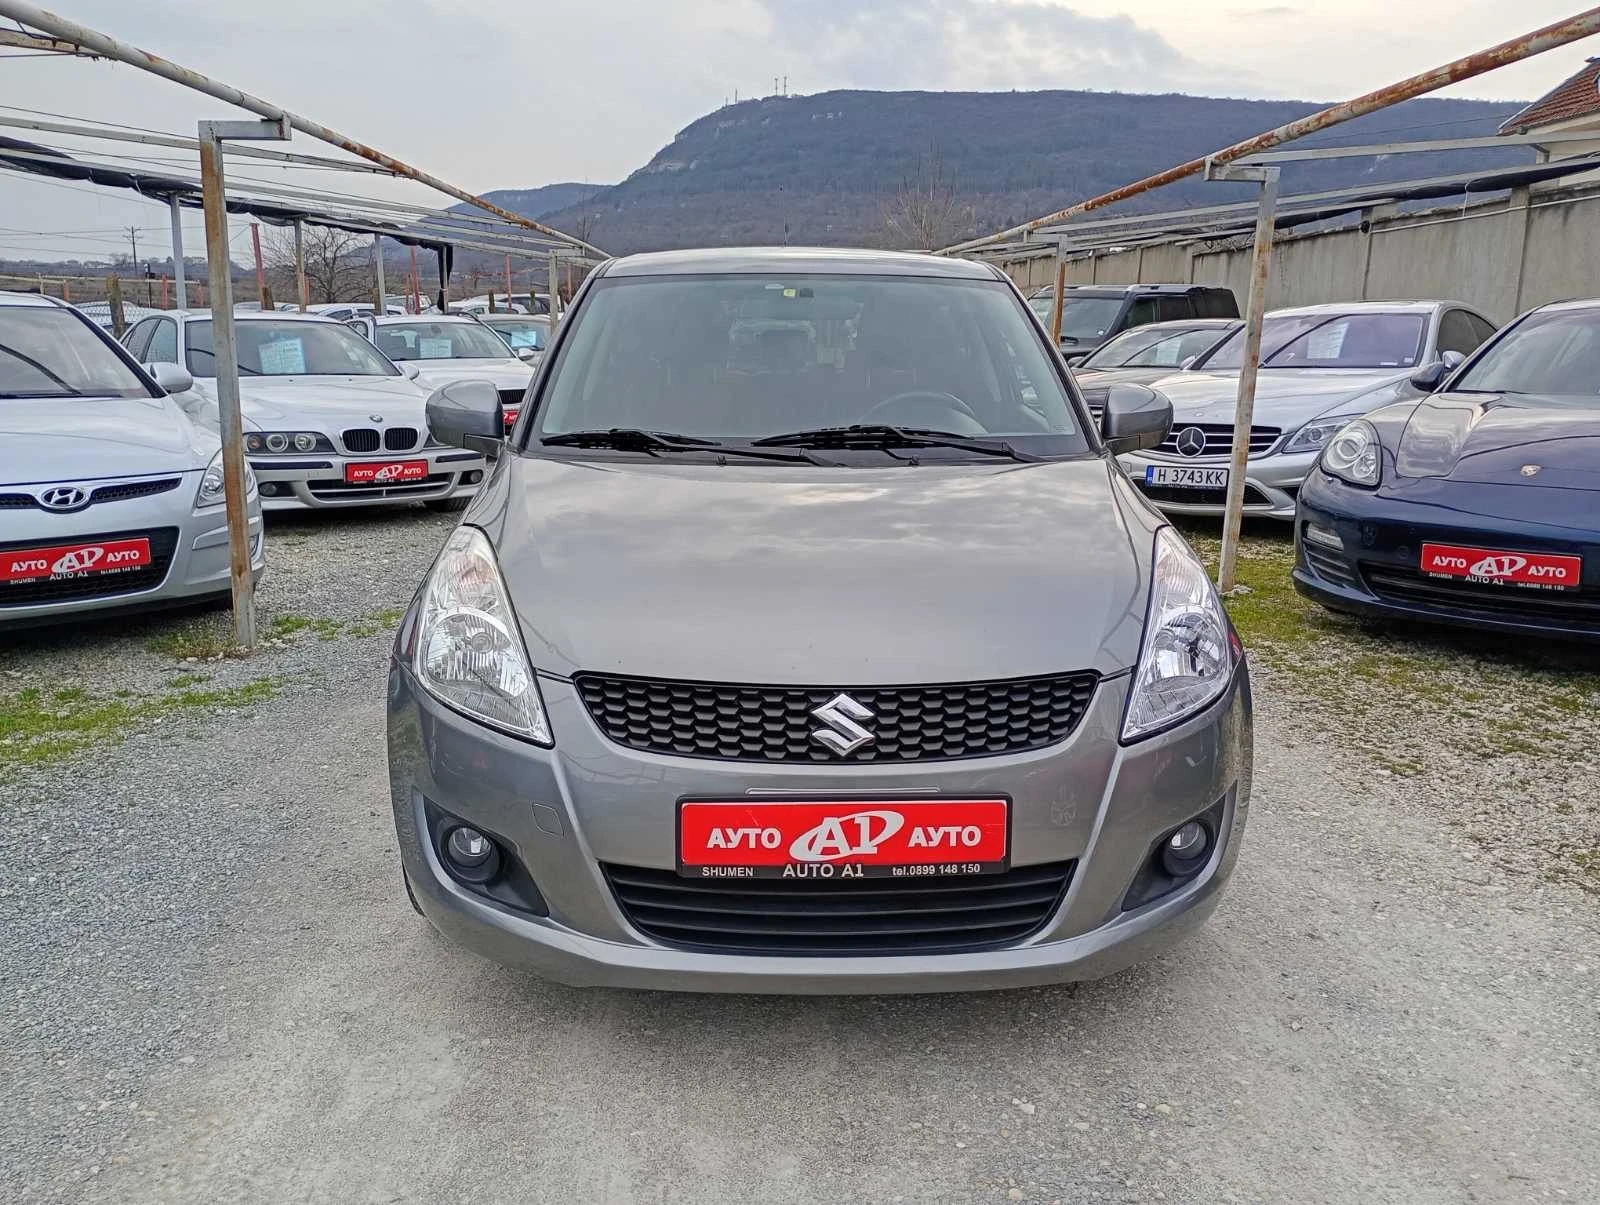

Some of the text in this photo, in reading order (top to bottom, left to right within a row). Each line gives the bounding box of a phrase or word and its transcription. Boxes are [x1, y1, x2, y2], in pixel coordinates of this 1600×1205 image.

[1159, 469, 1167, 482] H
[11, 559, 48, 573] АУТО
[106, 550, 140, 563] АУТО
[1432, 555, 1467, 569] АУТО
[1528, 565, 1567, 578] АУТО
[50, 571, 74, 581] AUTO
[77, 570, 89, 578] A1
[1465, 574, 1490, 584] AUTO
[1491, 577, 1504, 586] A1
[706, 827, 782, 850] АУТО
[907, 825, 983, 848] АУТО
[702, 863, 981, 878] SHUMEN AUTO A1 tel.0899 148 150
